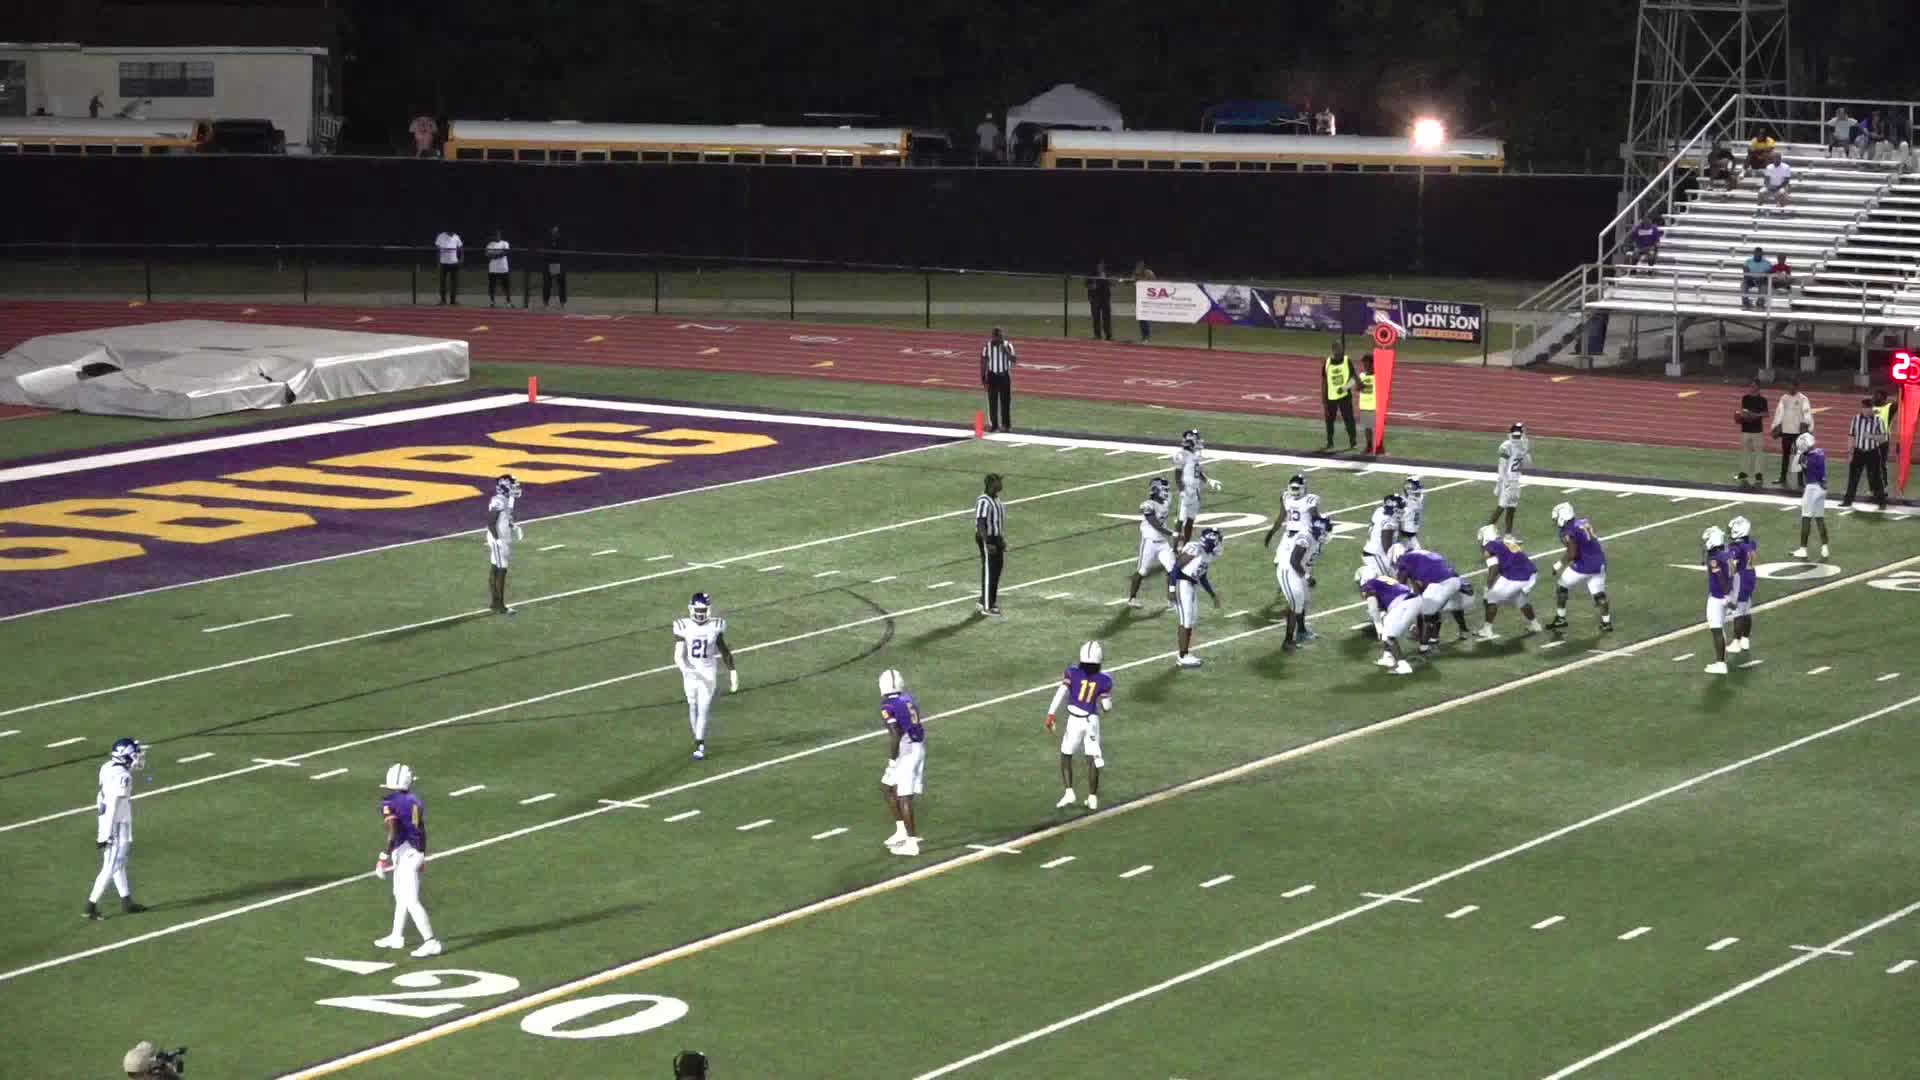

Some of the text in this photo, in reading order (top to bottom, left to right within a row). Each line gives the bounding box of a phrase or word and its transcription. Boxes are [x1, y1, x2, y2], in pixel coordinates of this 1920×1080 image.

[1146, 287, 1170, 298] SA
[1425, 303, 1462, 315] CHRIS
[1407, 313, 1480, 331] JOHNSON
[1892, 352, 1911, 380] 2
[691, 638, 709, 659] 21
[1079, 679, 1098, 704] 11
[314, 968, 689, 1039] 20
